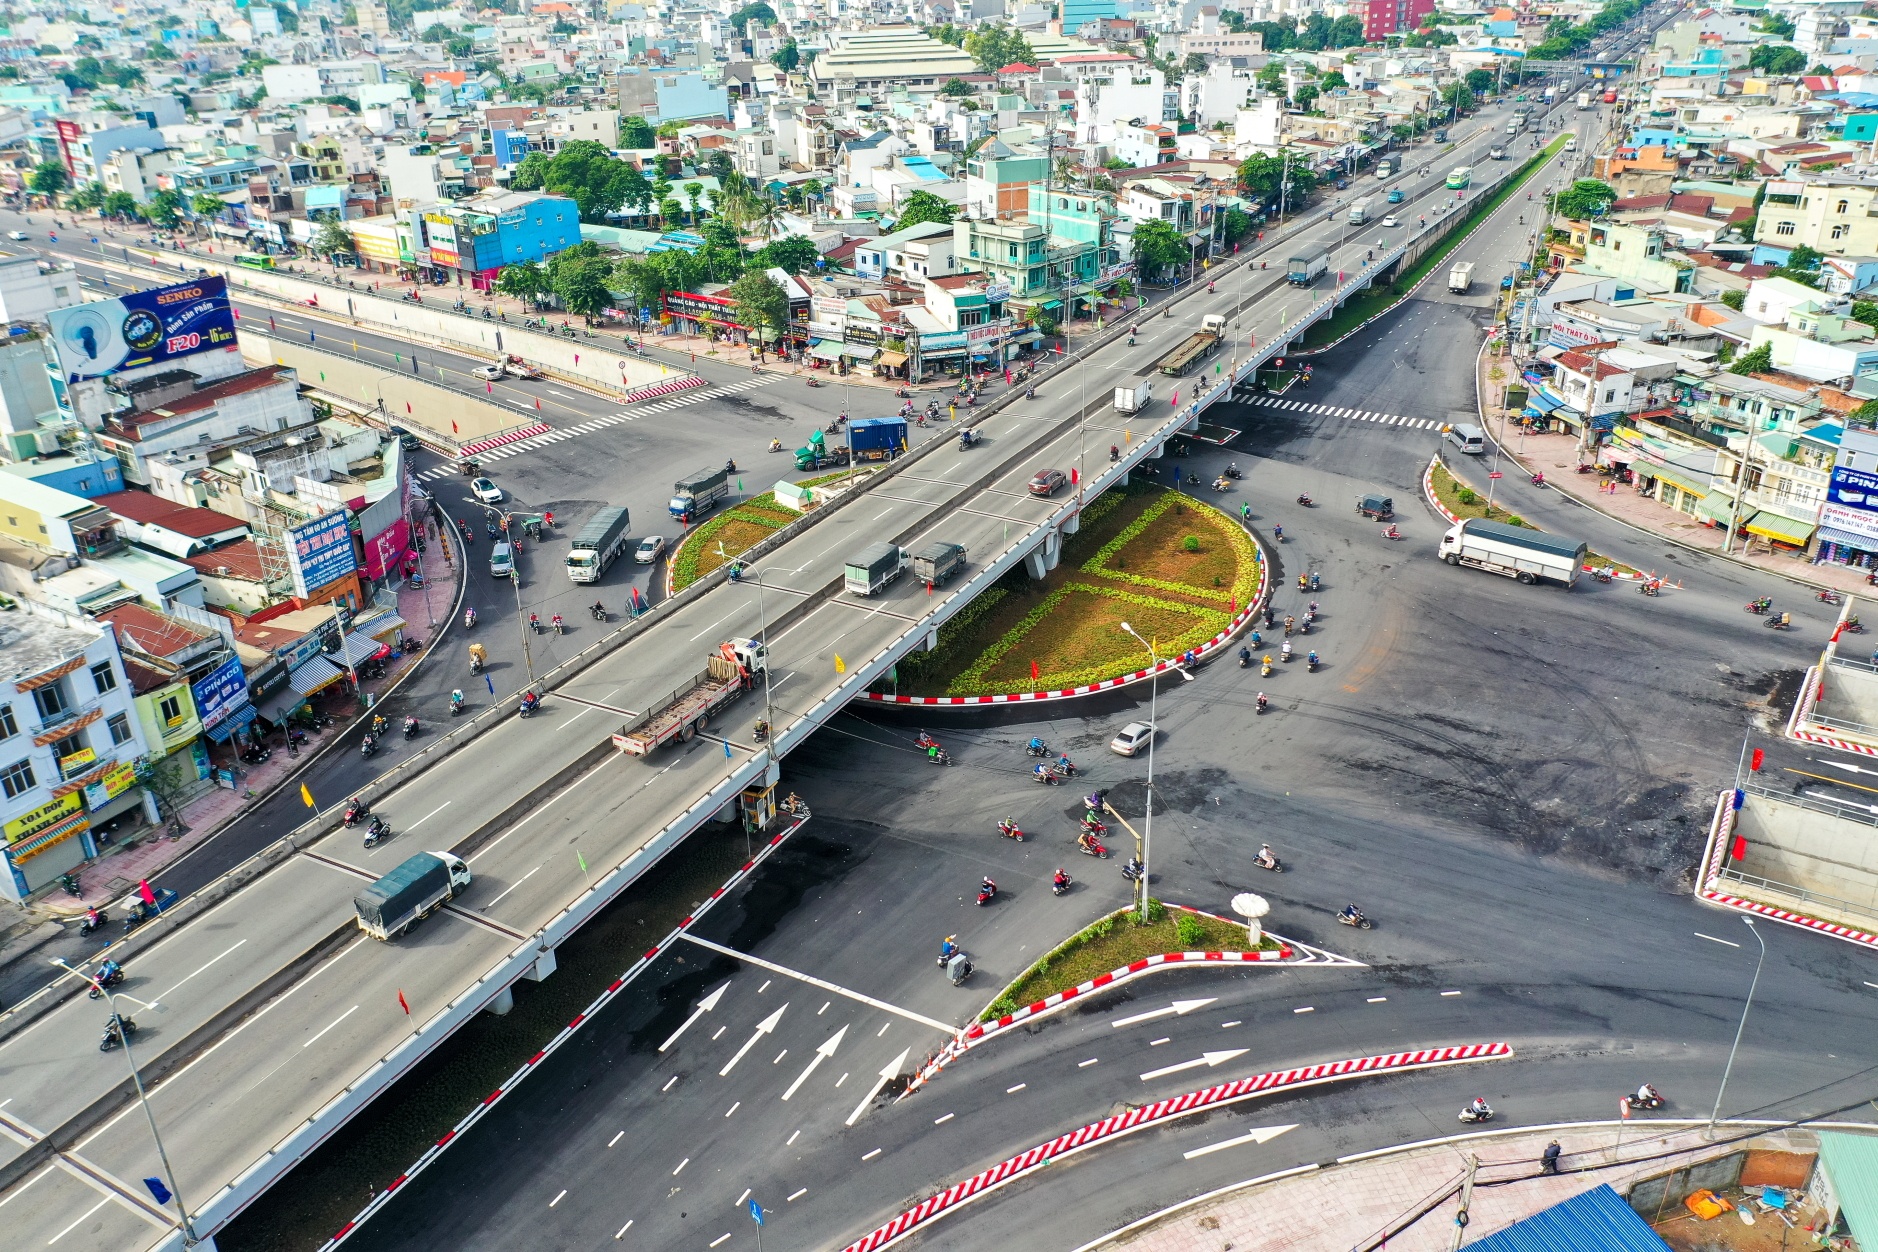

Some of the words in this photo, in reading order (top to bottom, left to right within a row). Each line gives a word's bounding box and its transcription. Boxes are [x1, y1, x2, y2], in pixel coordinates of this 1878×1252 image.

[156, 288, 202, 304] SENKO
[182, 311, 194, 322] Sản
[194, 302, 214, 314] Phẩm
[167, 332, 200, 353] F20
[1590, 336, 1598, 344] TÔ
[204, 666, 240, 695] PINACO
[19, 810, 41, 827] XOA
[43, 798, 65, 814] BÓP
